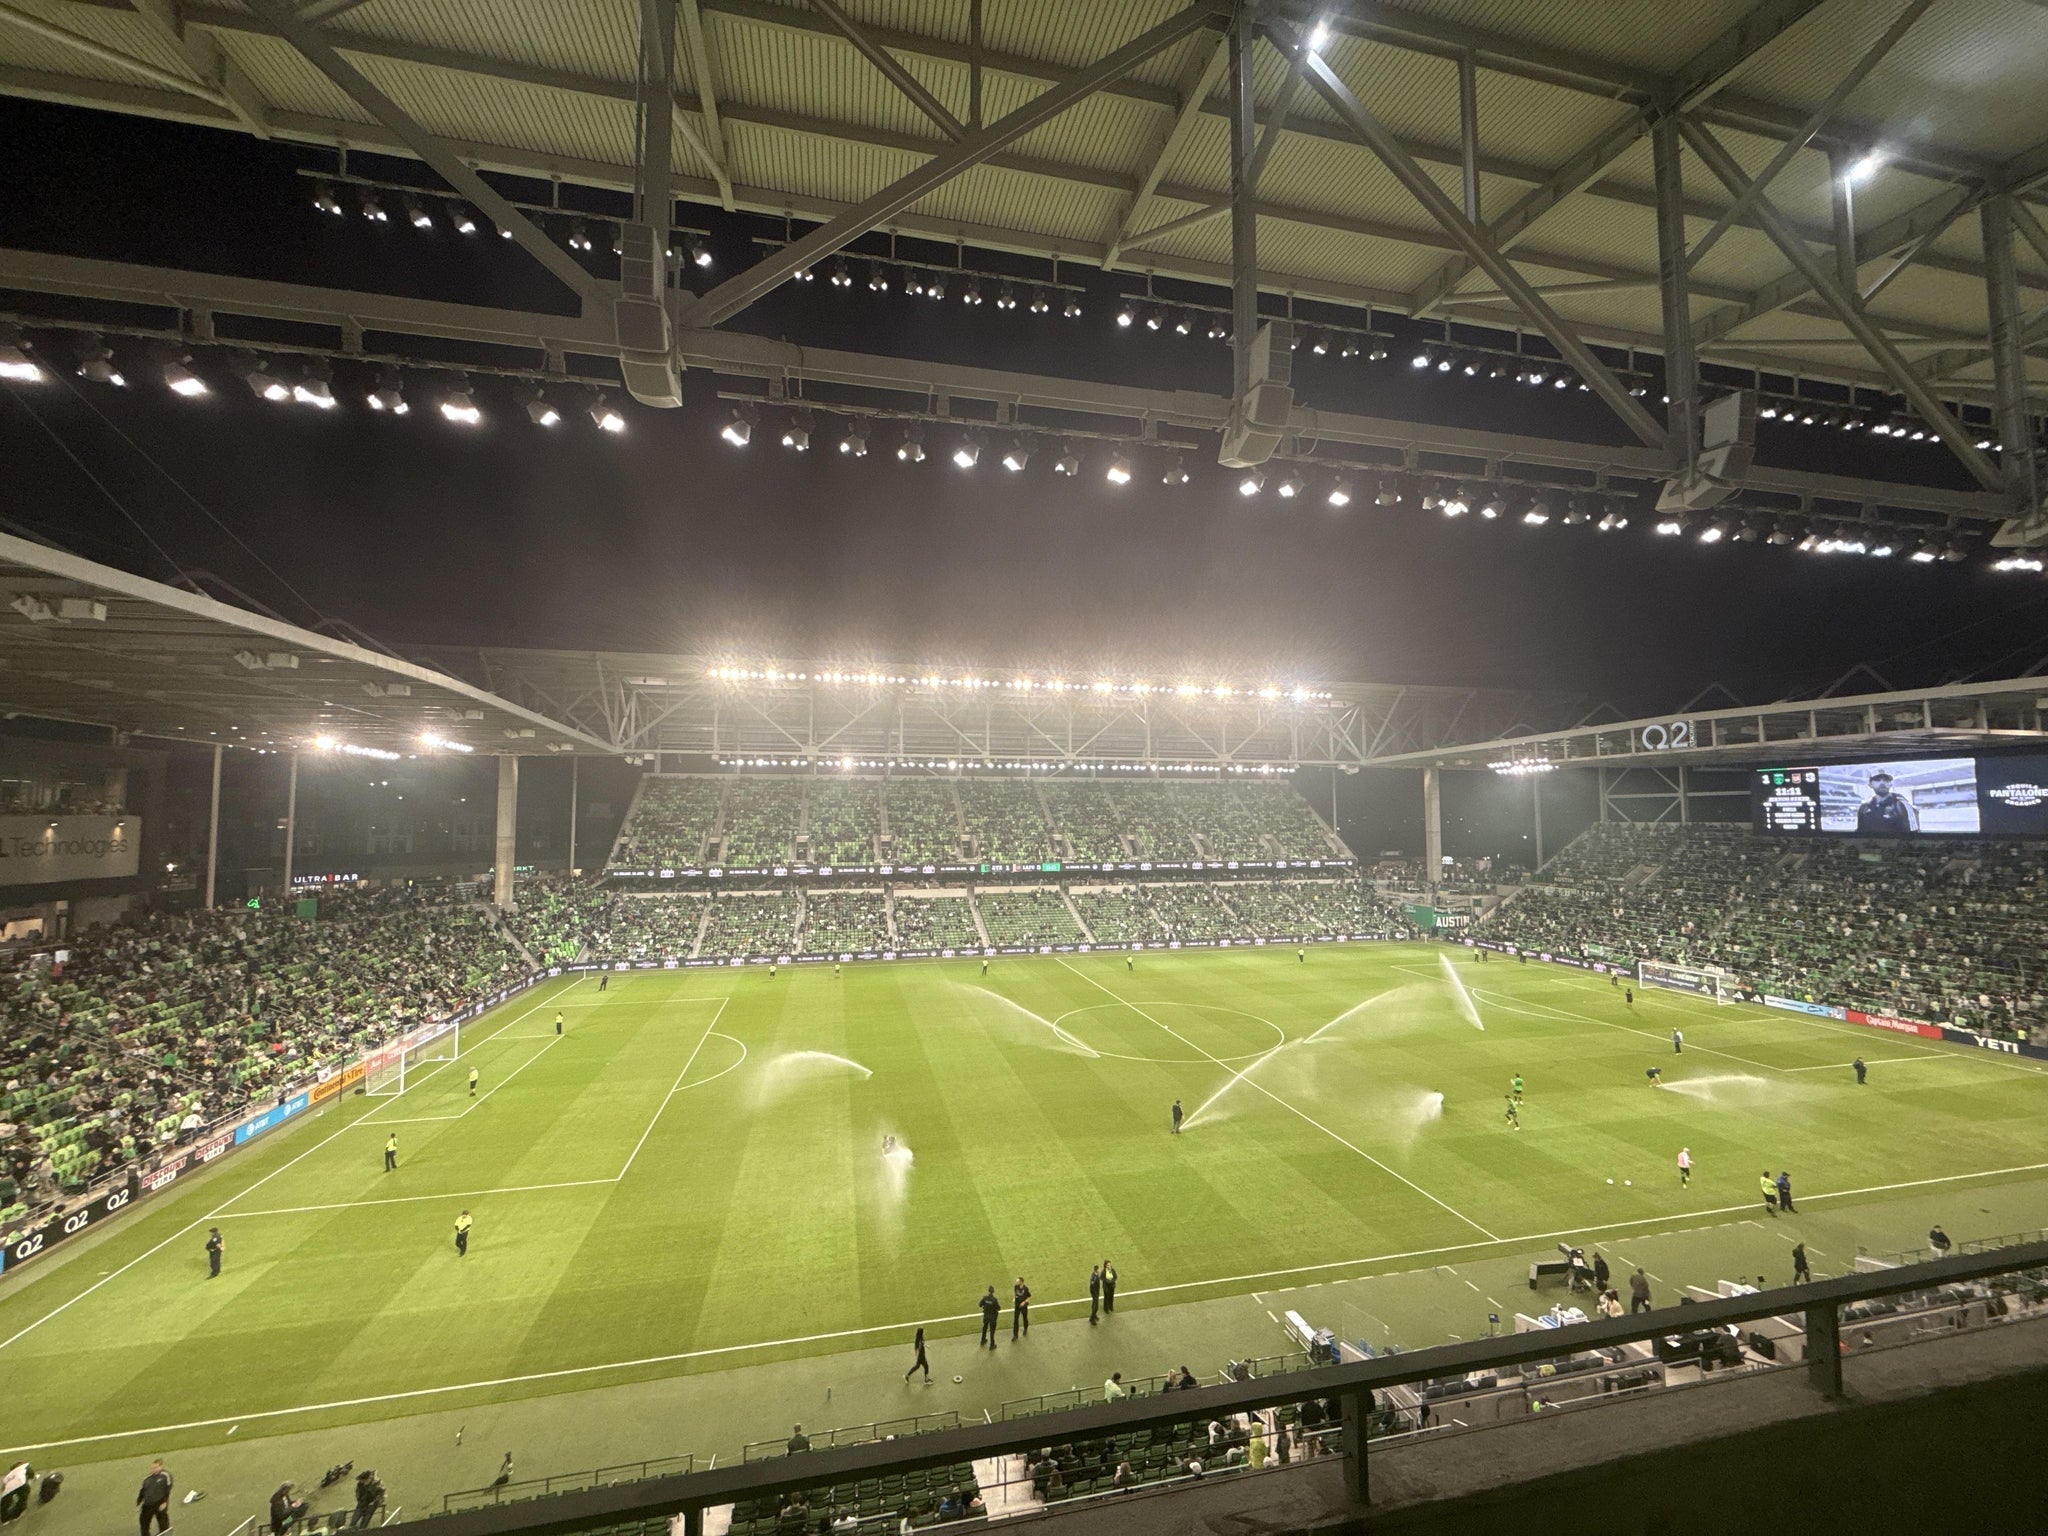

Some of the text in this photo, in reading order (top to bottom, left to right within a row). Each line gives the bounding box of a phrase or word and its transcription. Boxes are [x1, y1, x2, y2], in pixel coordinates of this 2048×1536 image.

[1641, 721, 1689, 750] Q2
[294, 873, 359, 884] ULTRA BAR
[1973, 1035, 2019, 1054] YETI
[195, 1131, 235, 1161] DISCOUNT
[141, 1155, 188, 1189] DISCOUNT
[107, 1188, 129, 1211] Q2
[64, 1210, 89, 1234] Q2
[16, 1233, 44, 1260] Q2
